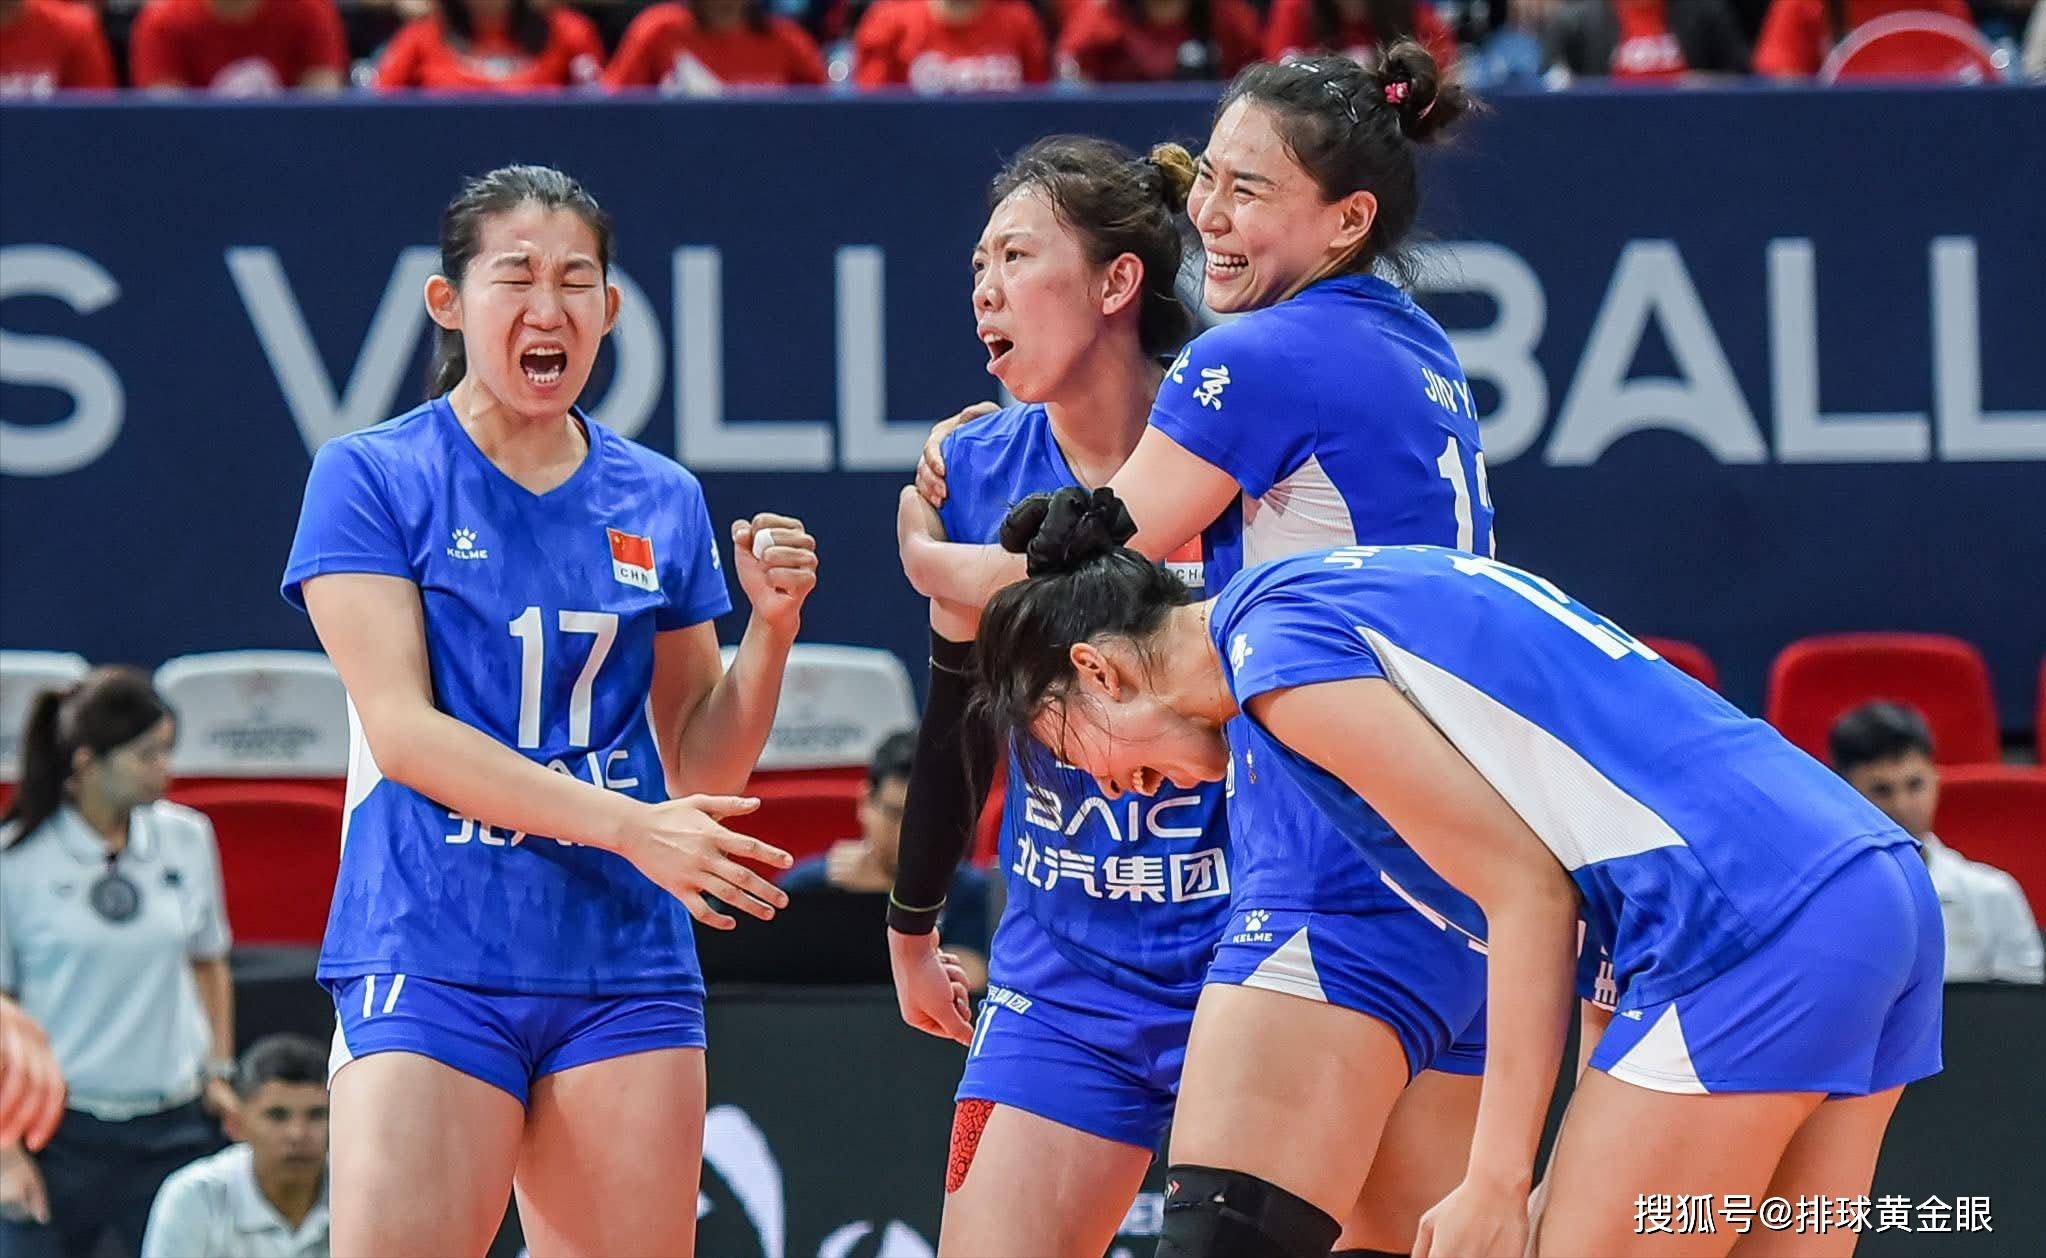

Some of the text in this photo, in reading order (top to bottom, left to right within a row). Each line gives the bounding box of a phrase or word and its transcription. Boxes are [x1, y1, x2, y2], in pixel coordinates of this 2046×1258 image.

[447, 548, 488, 560] KELME
[620, 567, 650, 584] CHN
[1176, 568, 1205, 581] CH
[508, 607, 619, 749] 17
[1025, 784, 1202, 842] BAIC
[1012, 831, 1231, 903] 北汽集团
[1232, 932, 1273, 944] KELME
